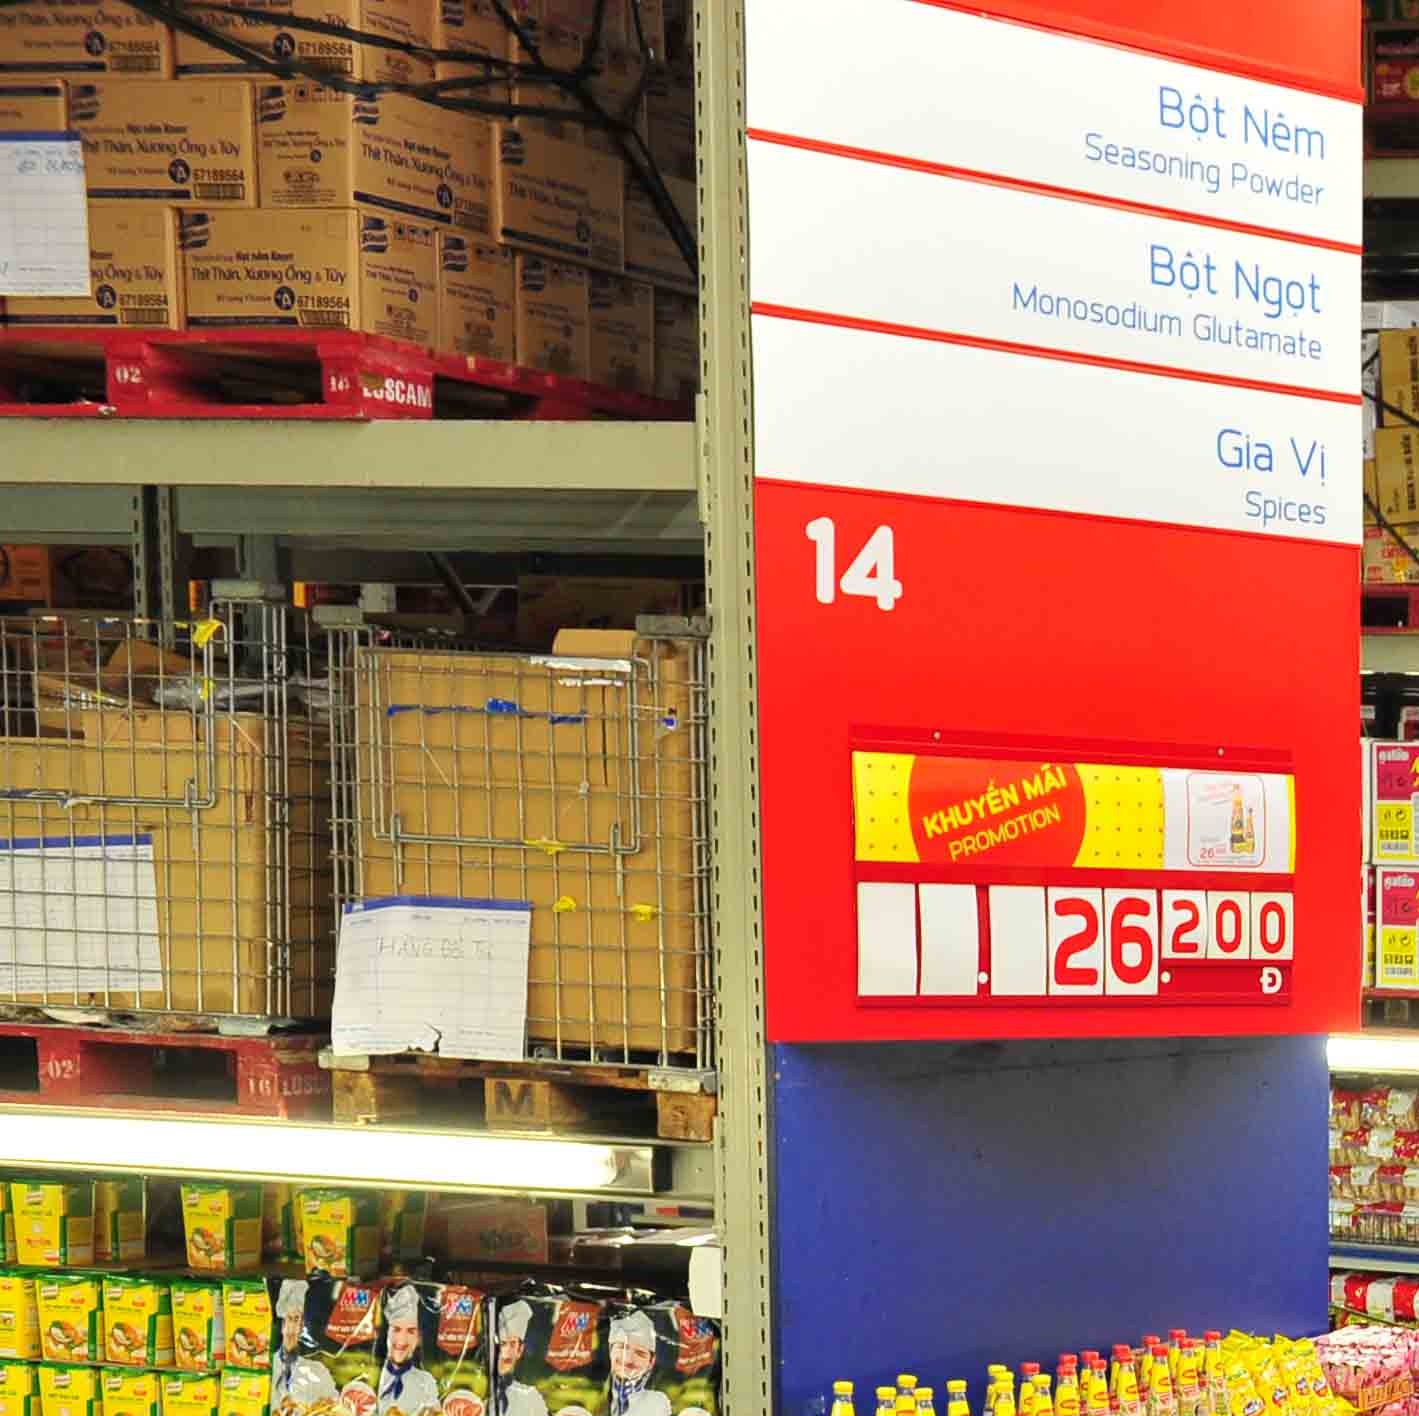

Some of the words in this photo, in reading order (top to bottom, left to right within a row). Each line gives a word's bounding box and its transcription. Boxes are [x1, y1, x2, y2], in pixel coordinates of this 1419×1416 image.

[1158, 86, 1227, 141] Bột
[1085, 133, 1220, 193] Seasoning
[1231, 162, 1325, 206] Powder
[1149, 244, 1217, 298] Bột
[1234, 261, 1322, 319] Ngọt
[1011, 281, 1183, 338] Monosodium
[1193, 312, 1323, 360] Glutamate
[1216, 429, 1274, 472] Gia
[1292, 437, 1327, 487] Vị
[1245, 490, 1327, 527] Spices
[805, 516, 903, 611] 14
[921, 774, 1019, 840] KHUYẾN
[947, 804, 1061, 862] PROMOTION
